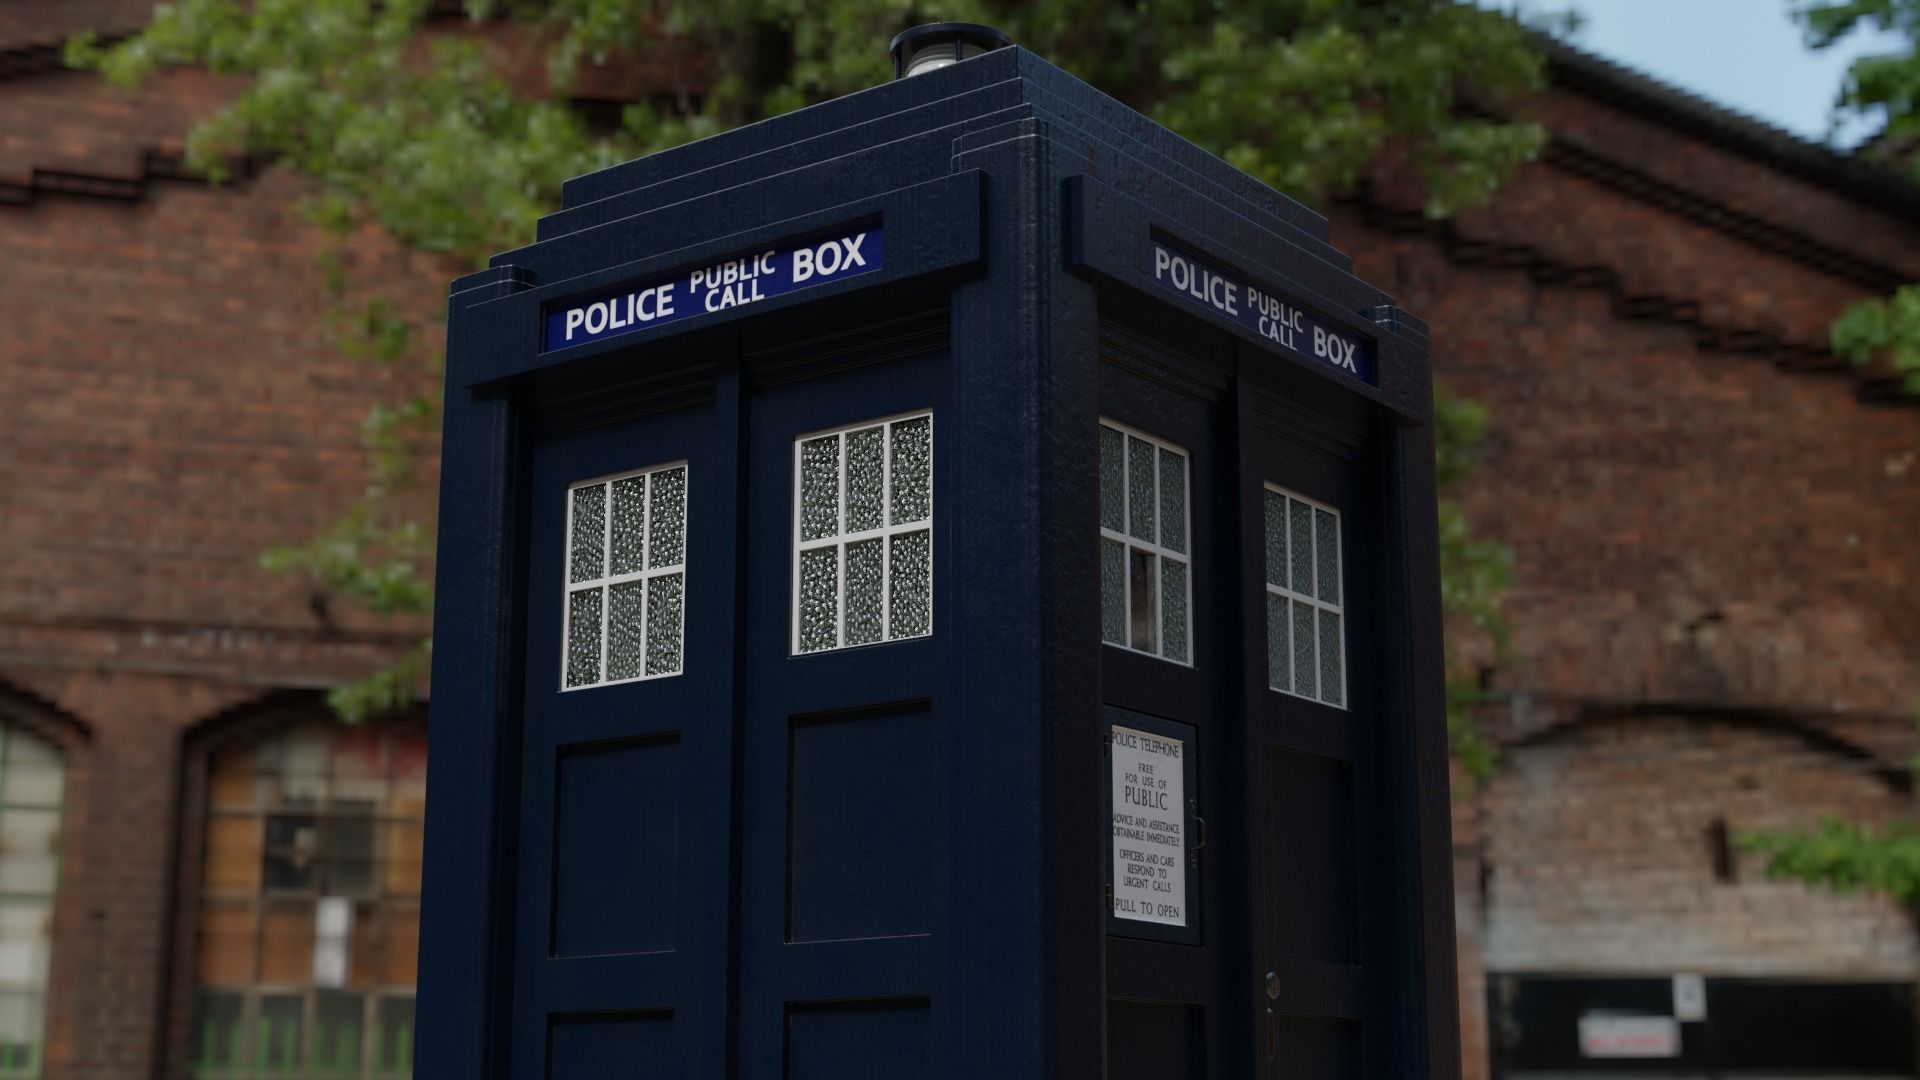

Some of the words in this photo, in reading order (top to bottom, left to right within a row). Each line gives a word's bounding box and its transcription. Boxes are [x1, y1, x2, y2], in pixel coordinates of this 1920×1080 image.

[566, 283, 674, 341] POLICE
[690, 250, 775, 294] PUBLIC
[793, 233, 867, 283] BOX
[704, 279, 765, 313] CALL
[1155, 247, 1238, 316] POLICE
[1248, 286, 1304, 333] PUBLIC
[1313, 325, 1357, 374] BOX
[1258, 317, 1298, 351] CALL
[1112, 731, 1137, 749] POLICE
[1140, 737, 1179, 758] TELEPHONE
[1138, 763, 1154, 775] FREE
[1125, 773, 1137, 784] FOR
[1142, 776, 1154, 788] USE
[1158, 779, 1167, 789] OF
[1125, 786, 1168, 810] PUBLIC
[1113, 813, 1133, 826] ADVICE
[1135, 818, 1147, 829] AND
[1149, 821, 1180, 834] ASSISTANCE
[1113, 826, 1145, 842] OBTAINABLE
[1146, 830, 1180, 847] IMMEDIATELY
[1120, 848, 1145, 863] OFFICERS
[1146, 853, 1158, 865] AND
[1160, 855, 1174, 867] CARS
[1127, 863, 1155, 878] RESPOND
[1158, 868, 1167, 879] TO
[1123, 876, 1148, 890] URGENT
[1153, 881, 1171, 893] CALLS
[1115, 898, 1136, 913] PULL
[1140, 901, 1152, 915] TO
[1157, 903, 1179, 918] OPEN
